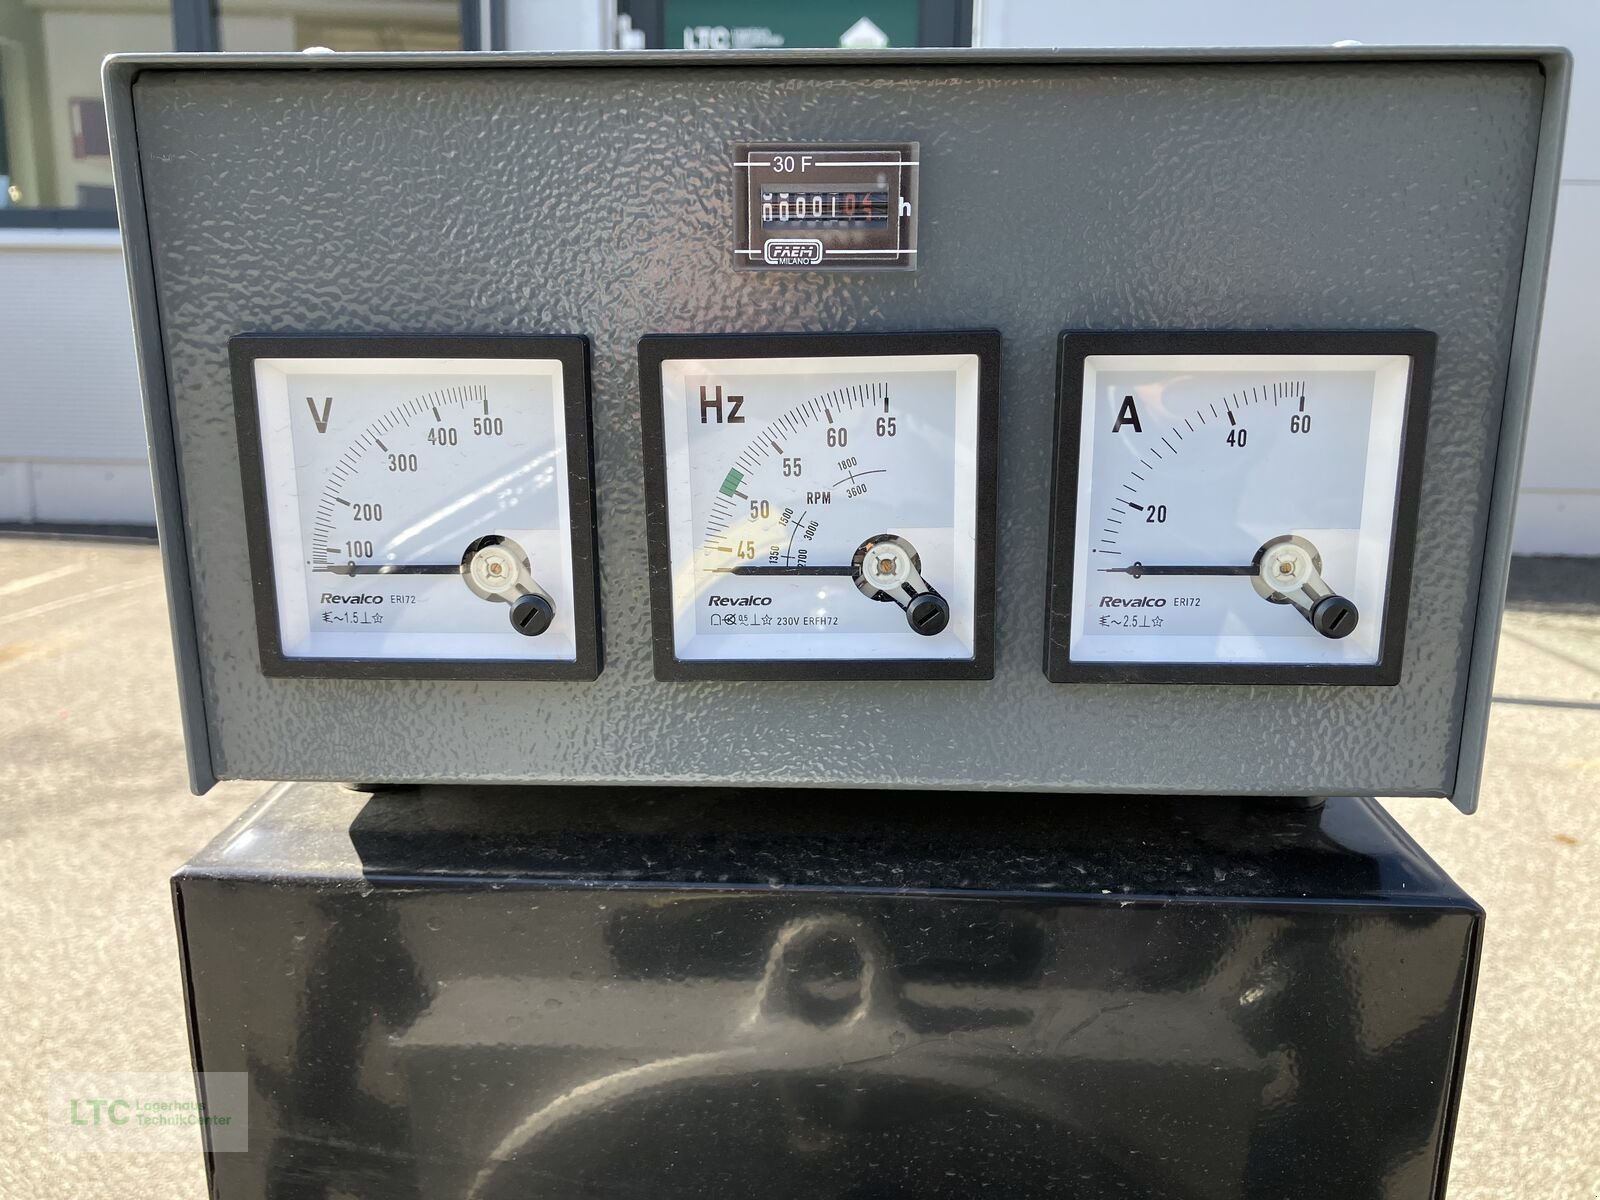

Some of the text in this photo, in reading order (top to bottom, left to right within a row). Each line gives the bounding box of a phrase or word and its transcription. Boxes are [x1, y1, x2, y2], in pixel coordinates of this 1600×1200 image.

[773, 156, 813, 172] 30 F
[899, 197, 911, 216] h
[773, 246, 813, 257] FAEM
[700, 385, 745, 424] Hz
[306, 397, 333, 433] V
[1112, 396, 1142, 432] A
[473, 418, 503, 436] 500
[876, 417, 896, 437] 65
[1290, 415, 1311, 433] 60
[427, 428, 458, 446] 400
[826, 427, 848, 447] 60
[1226, 429, 1247, 447] 40
[388, 454, 418, 472] 300
[783, 458, 802, 477] 55
[837, 457, 858, 471] 1800
[806, 491, 831, 505] RPM
[847, 483, 868, 499] 3600
[353, 503, 383, 522] 200
[750, 500, 770, 519] 50
[778, 508, 794, 527] 1500
[1146, 505, 1167, 523] 20
[803, 521, 819, 541] 3000
[346, 540, 373, 558] 100
[737, 541, 755, 559] 45
[769, 546, 780, 564] 1350
[320, 593, 416, 605] Revalco ERI72
[708, 595, 772, 607] Revalco
[1099, 596, 1201, 608] Revalco ERI72
[777, 617, 800, 626] 230V
[803, 617, 839, 626] ERFH72
